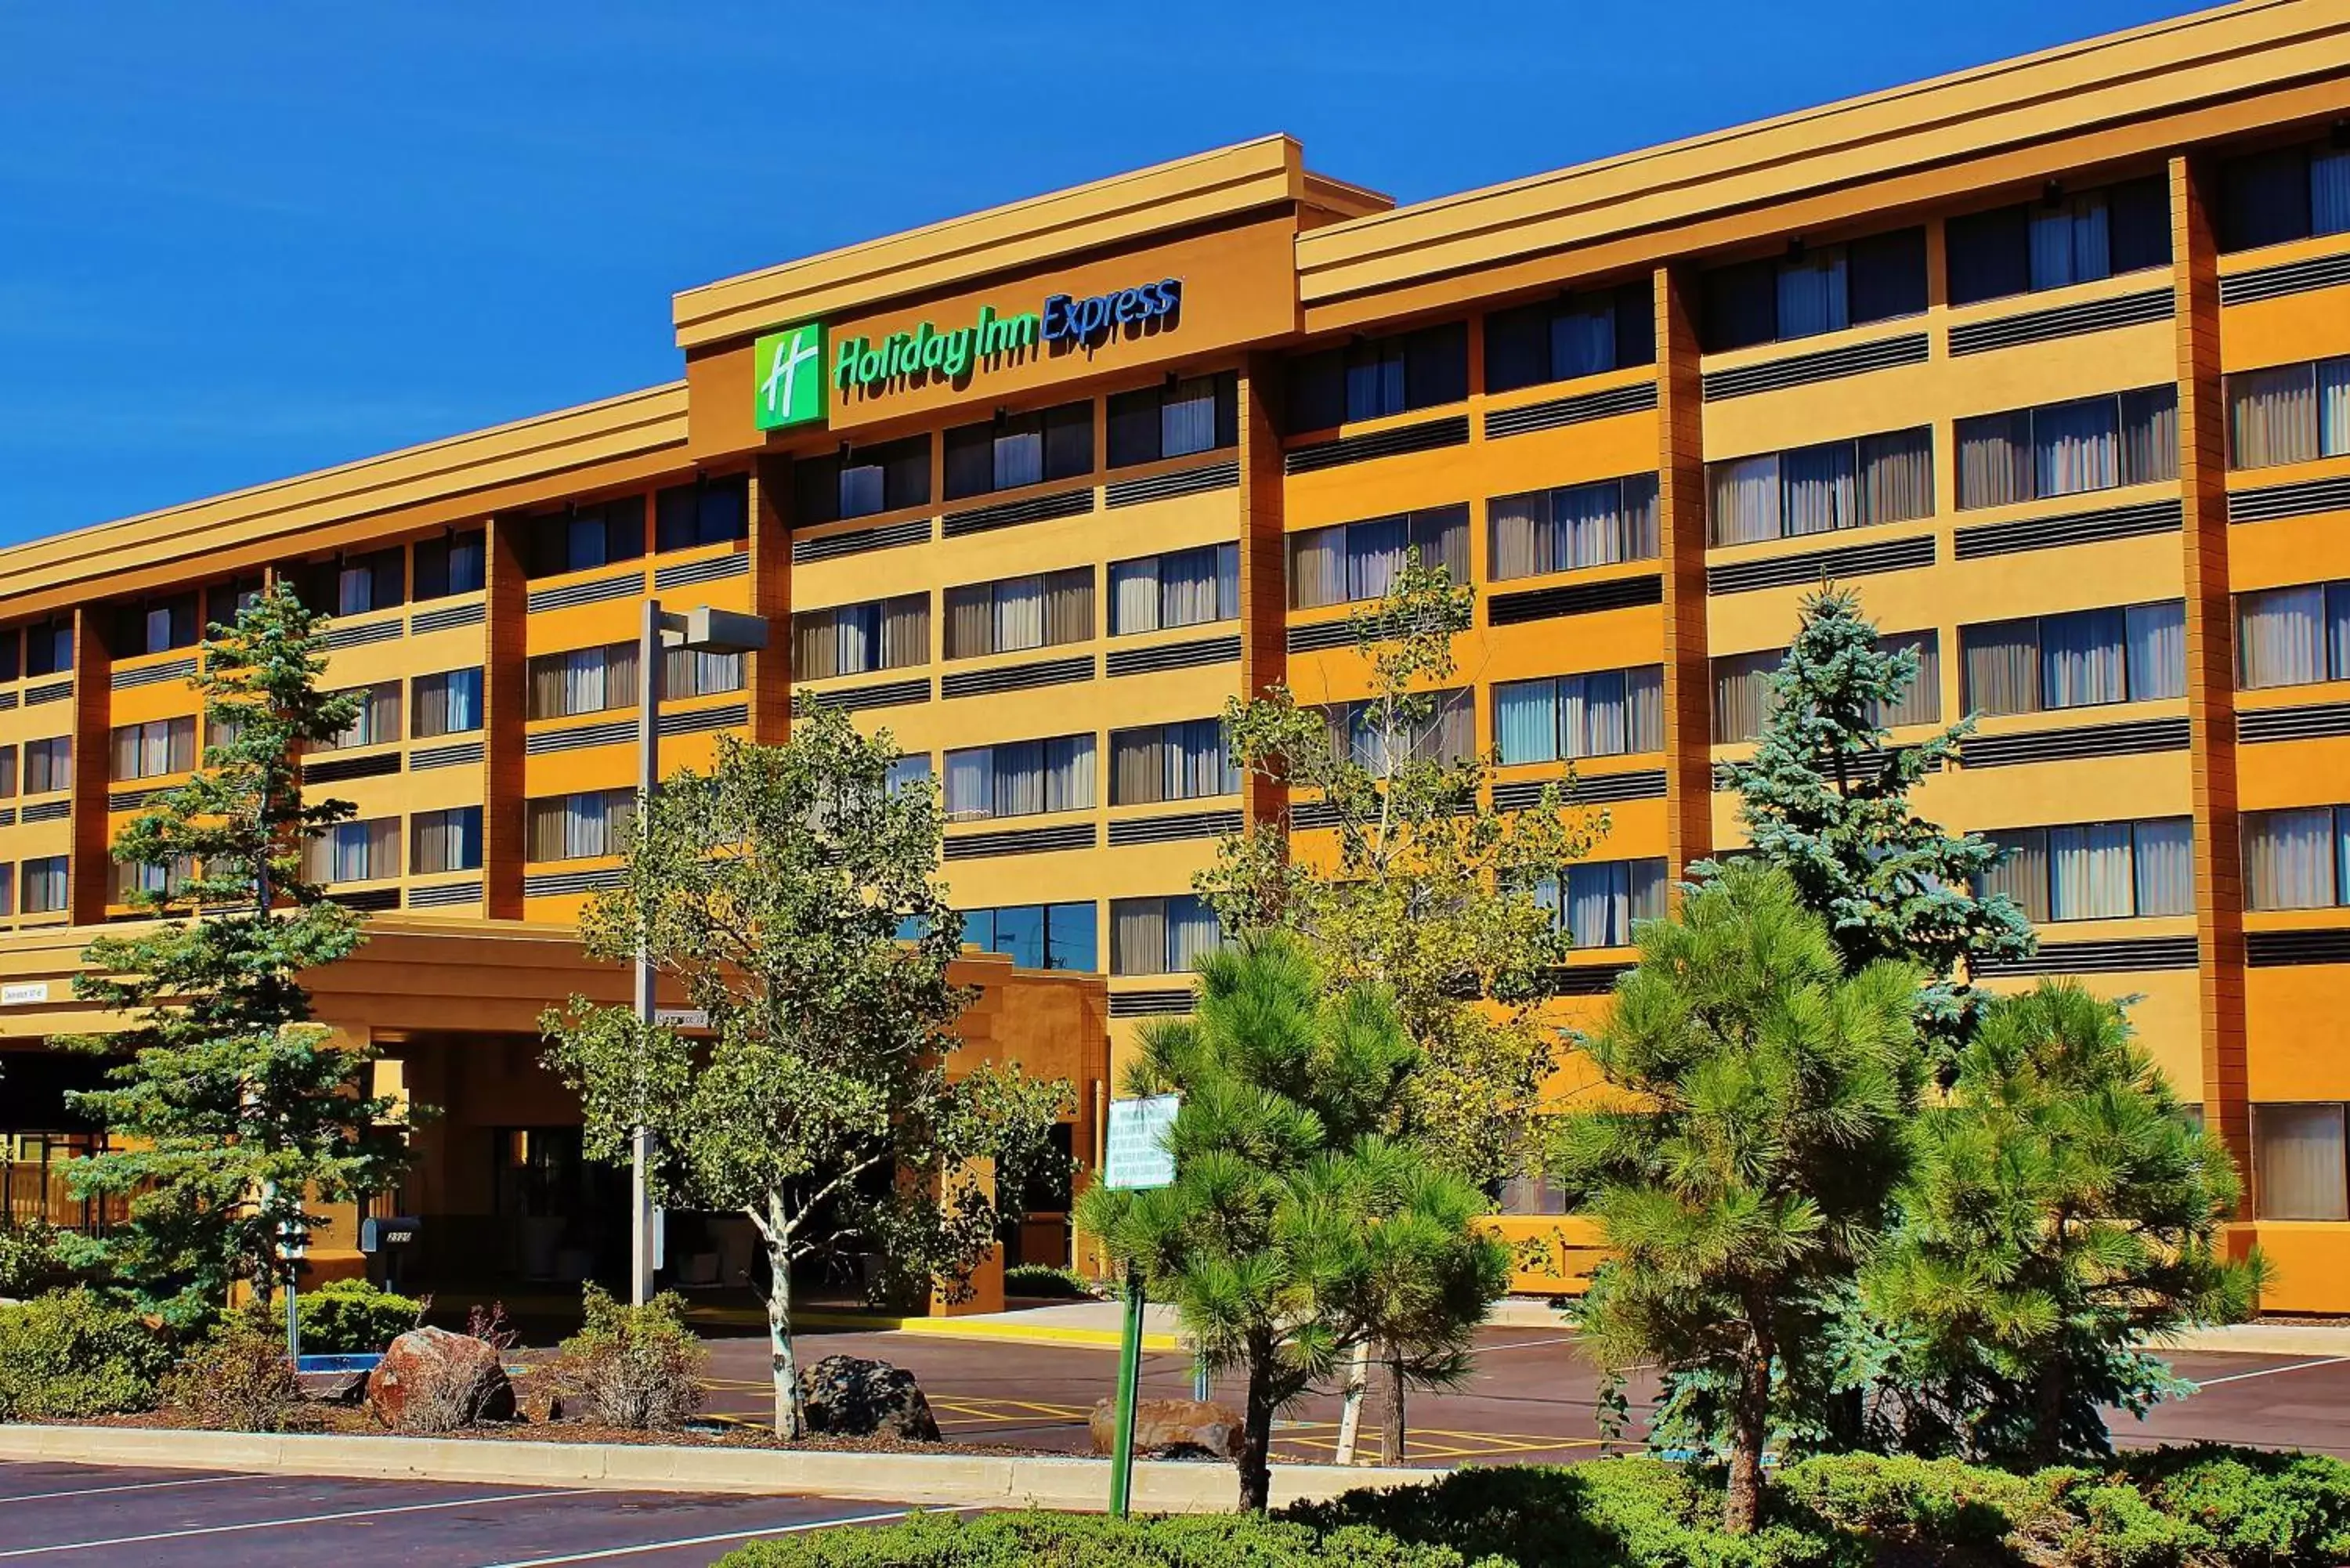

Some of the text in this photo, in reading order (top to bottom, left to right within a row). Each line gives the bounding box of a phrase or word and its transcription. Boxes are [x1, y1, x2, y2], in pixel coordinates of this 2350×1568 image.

[833, 279, 1181, 390] Holiday Inn Express
